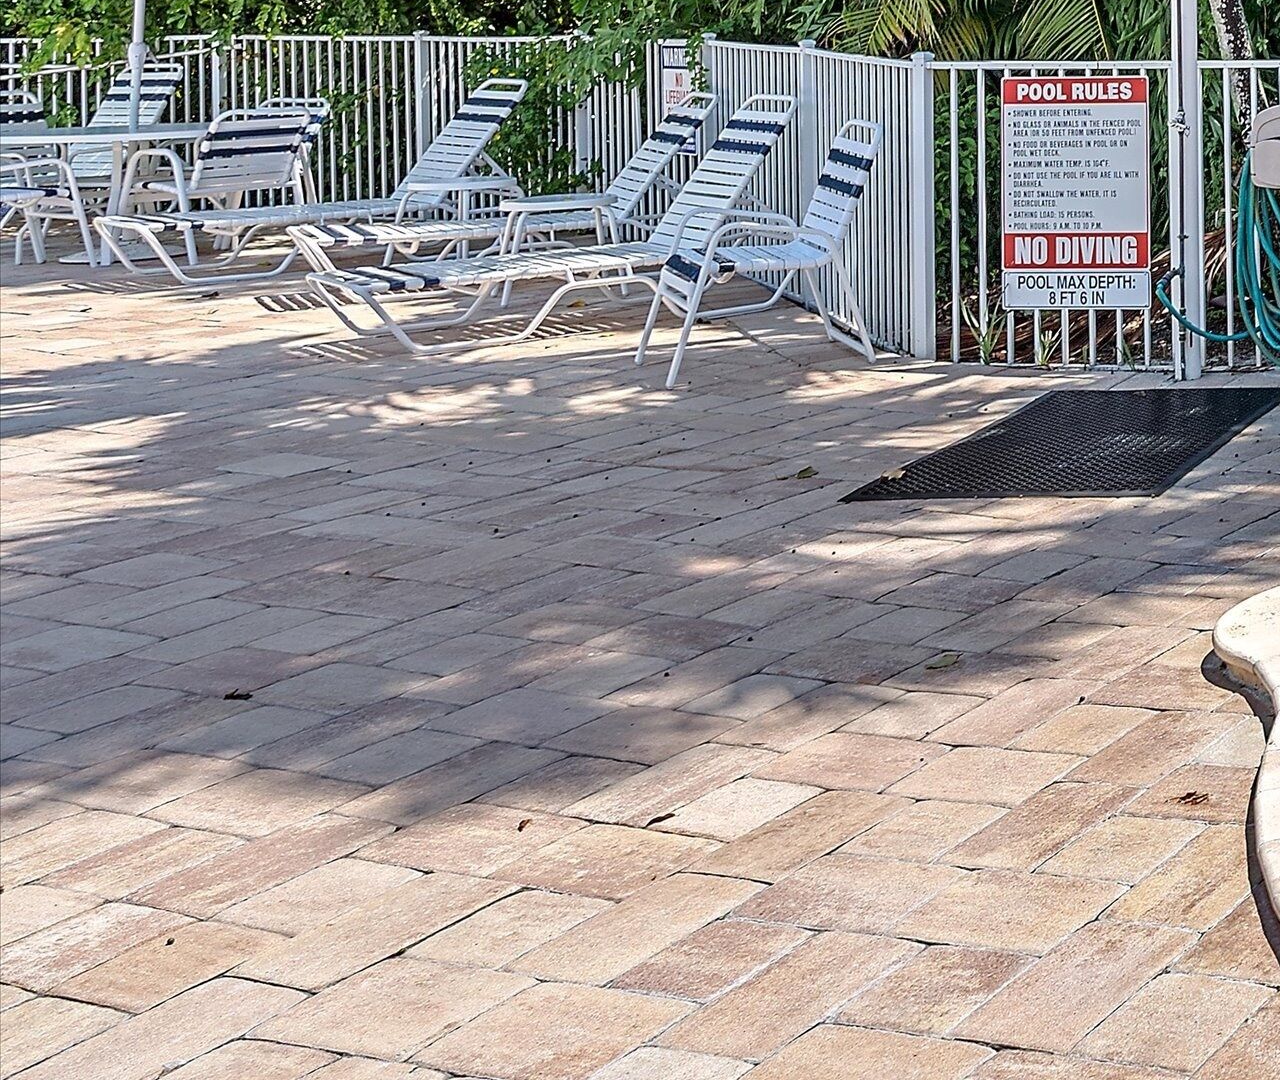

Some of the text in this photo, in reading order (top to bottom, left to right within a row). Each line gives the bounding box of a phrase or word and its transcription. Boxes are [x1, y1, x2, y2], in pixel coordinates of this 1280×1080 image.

[1017, 82, 1132, 100] POOL RULES
[1039, 109, 1060, 117] BEFORE
[1053, 120, 1079, 128] ANIMALS
[1126, 119, 1141, 127] POOL
[1013, 129, 1028, 137] AREA
[1041, 129, 1050, 137] 50
[1086, 128, 1116, 136] UNFENCED
[1050, 140, 1083, 148] BEVERAGES
[1030, 149, 1041, 157] WET
[1044, 160, 1064, 168] WATER
[1050, 171, 1061, 179] THE
[1063, 171, 1078, 179] POOL
[1080, 171, 1085, 179] IF
[1087, 171, 1099, 179] YOU
[1037, 190, 1064, 198] SWALLOW
[1067, 190, 1078, 198] THE
[1013, 211, 1038, 219] BATHING
[1053, 222, 1057, 230] 9
[1014, 236, 1138, 265] NO DIVING
[1018, 276, 1136, 289] POOL MAX DEPTH:
[1049, 291, 1104, 305] 8 FT 6 IN
